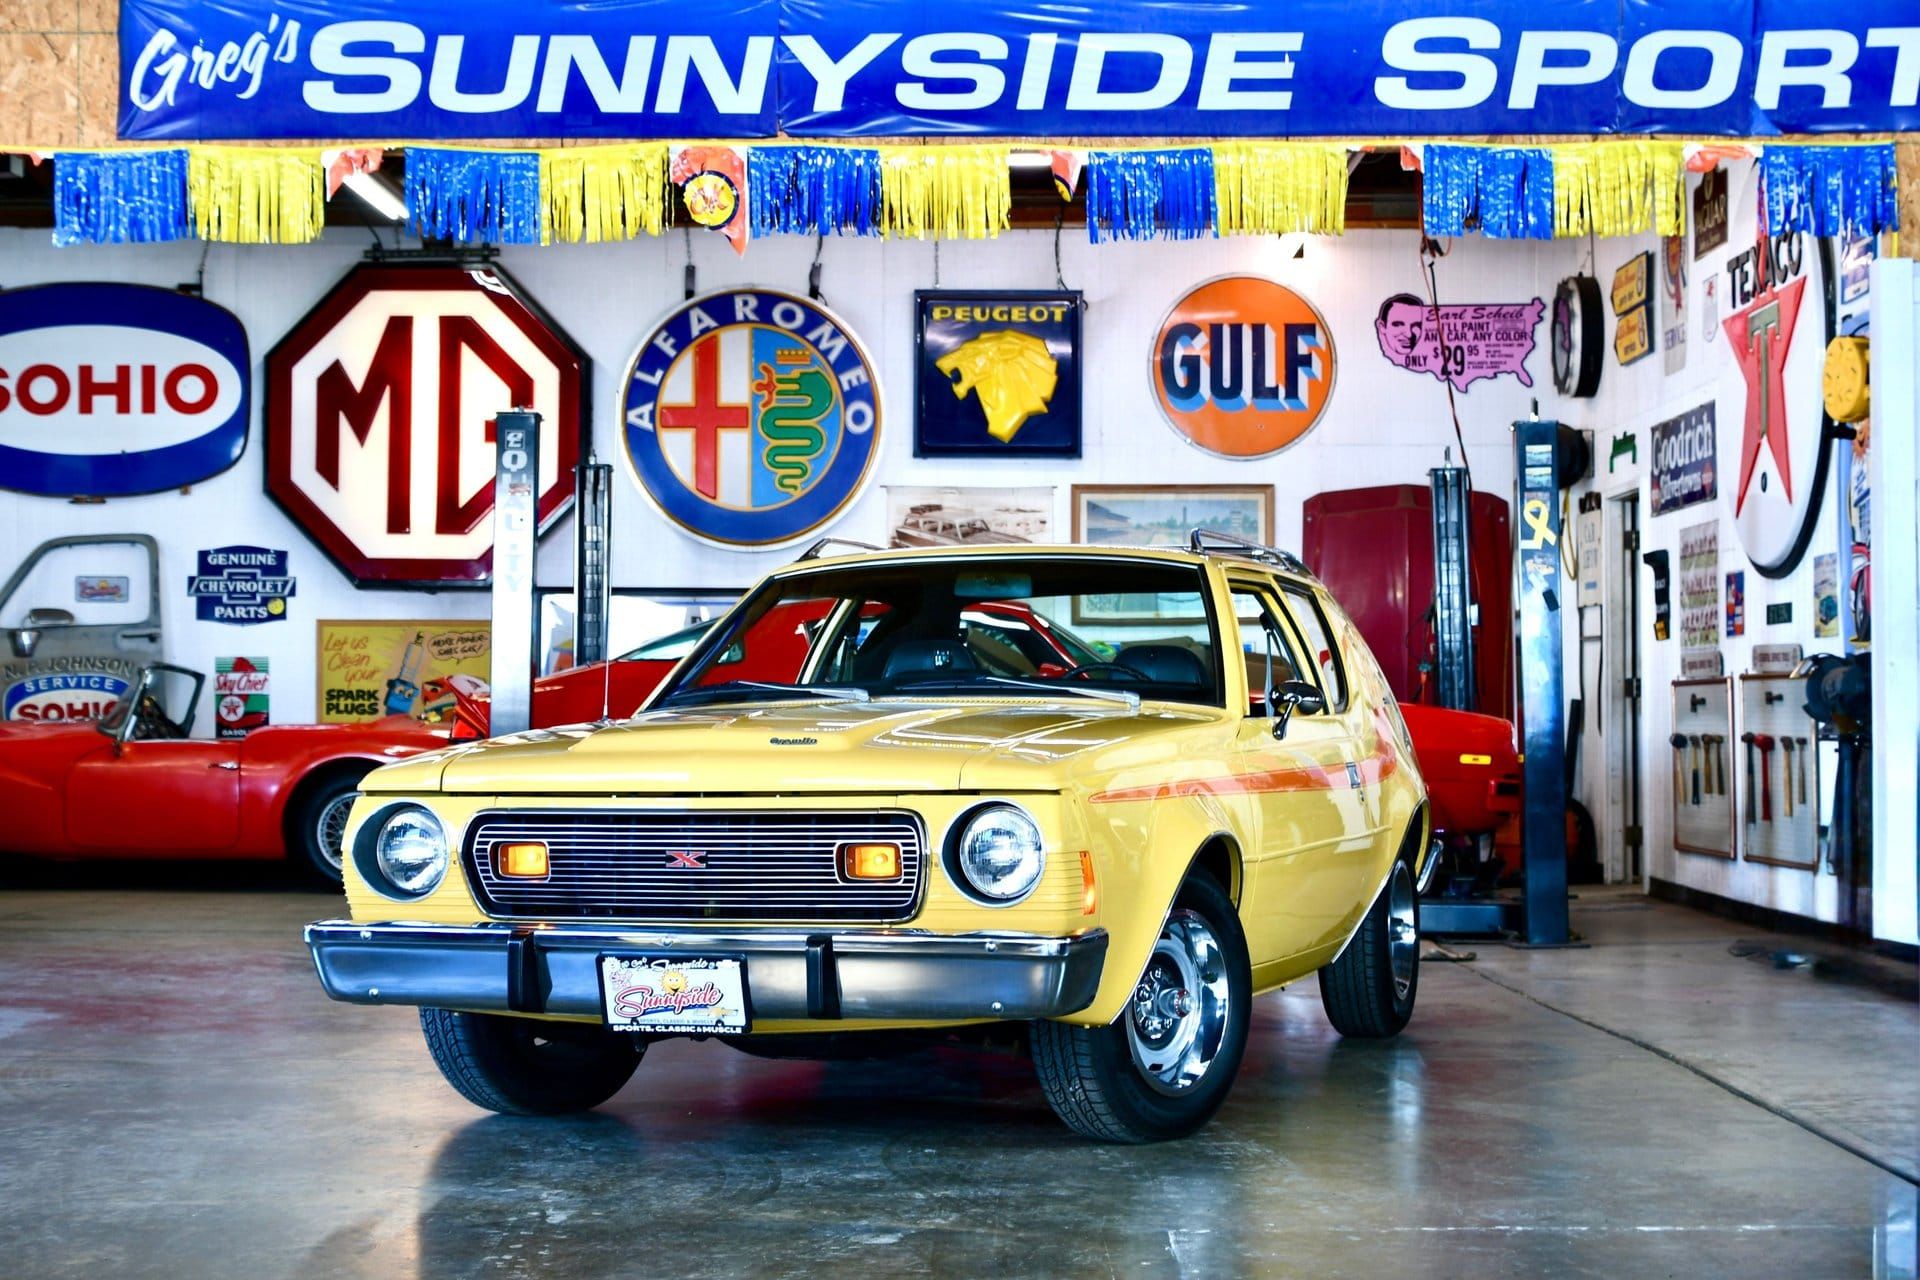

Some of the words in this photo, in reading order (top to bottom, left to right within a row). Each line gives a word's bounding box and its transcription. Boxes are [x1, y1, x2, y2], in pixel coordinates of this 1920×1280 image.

[129, 14, 300, 112] Greg's
[302, 20, 1304, 115] SUNNYSIDE
[1727, 218, 1802, 310] TEXACO
[931, 305, 1068, 324] PEUGEOT
[1426, 307, 1467, 322] Earl
[1471, 306, 1525, 320] Scheib
[1461, 322, 1490, 332] PAINT
[1424, 332, 1441, 342] AN
[1473, 332, 1492, 342] ANY
[1495, 331, 1527, 342] COLOR
[626, 304, 721, 433] ALFA
[734, 293, 875, 435] ROMEO
[1160, 322, 1323, 411] GULF
[1404, 355, 1428, 368] ONLY
[0, 363, 219, 417] OHIO
[316, 315, 534, 535] MG
[1652, 411, 1713, 476] Goodrich
[207, 553, 277, 565] GENUINE
[199, 581, 284, 592] CHEVROLET
[214, 606, 268, 618] PARTS
[324, 632, 348, 651] Let
[351, 636, 369, 650] us
[45, 654, 132, 678] JOHNSON
[328, 652, 371, 672] Clean
[24, 676, 115, 693] SERVICE
[216, 673, 236, 695] Sky
[237, 671, 268, 691] Chief
[343, 669, 380, 687] your
[325, 689, 379, 701] SPARK
[325, 702, 379, 715] PLUGS
[665, 850, 706, 868] X
[614, 982, 724, 1018] Sunnyside
[656, 1025, 696, 1033] CLASSIC
[703, 1025, 743, 1034] MUSCLE
